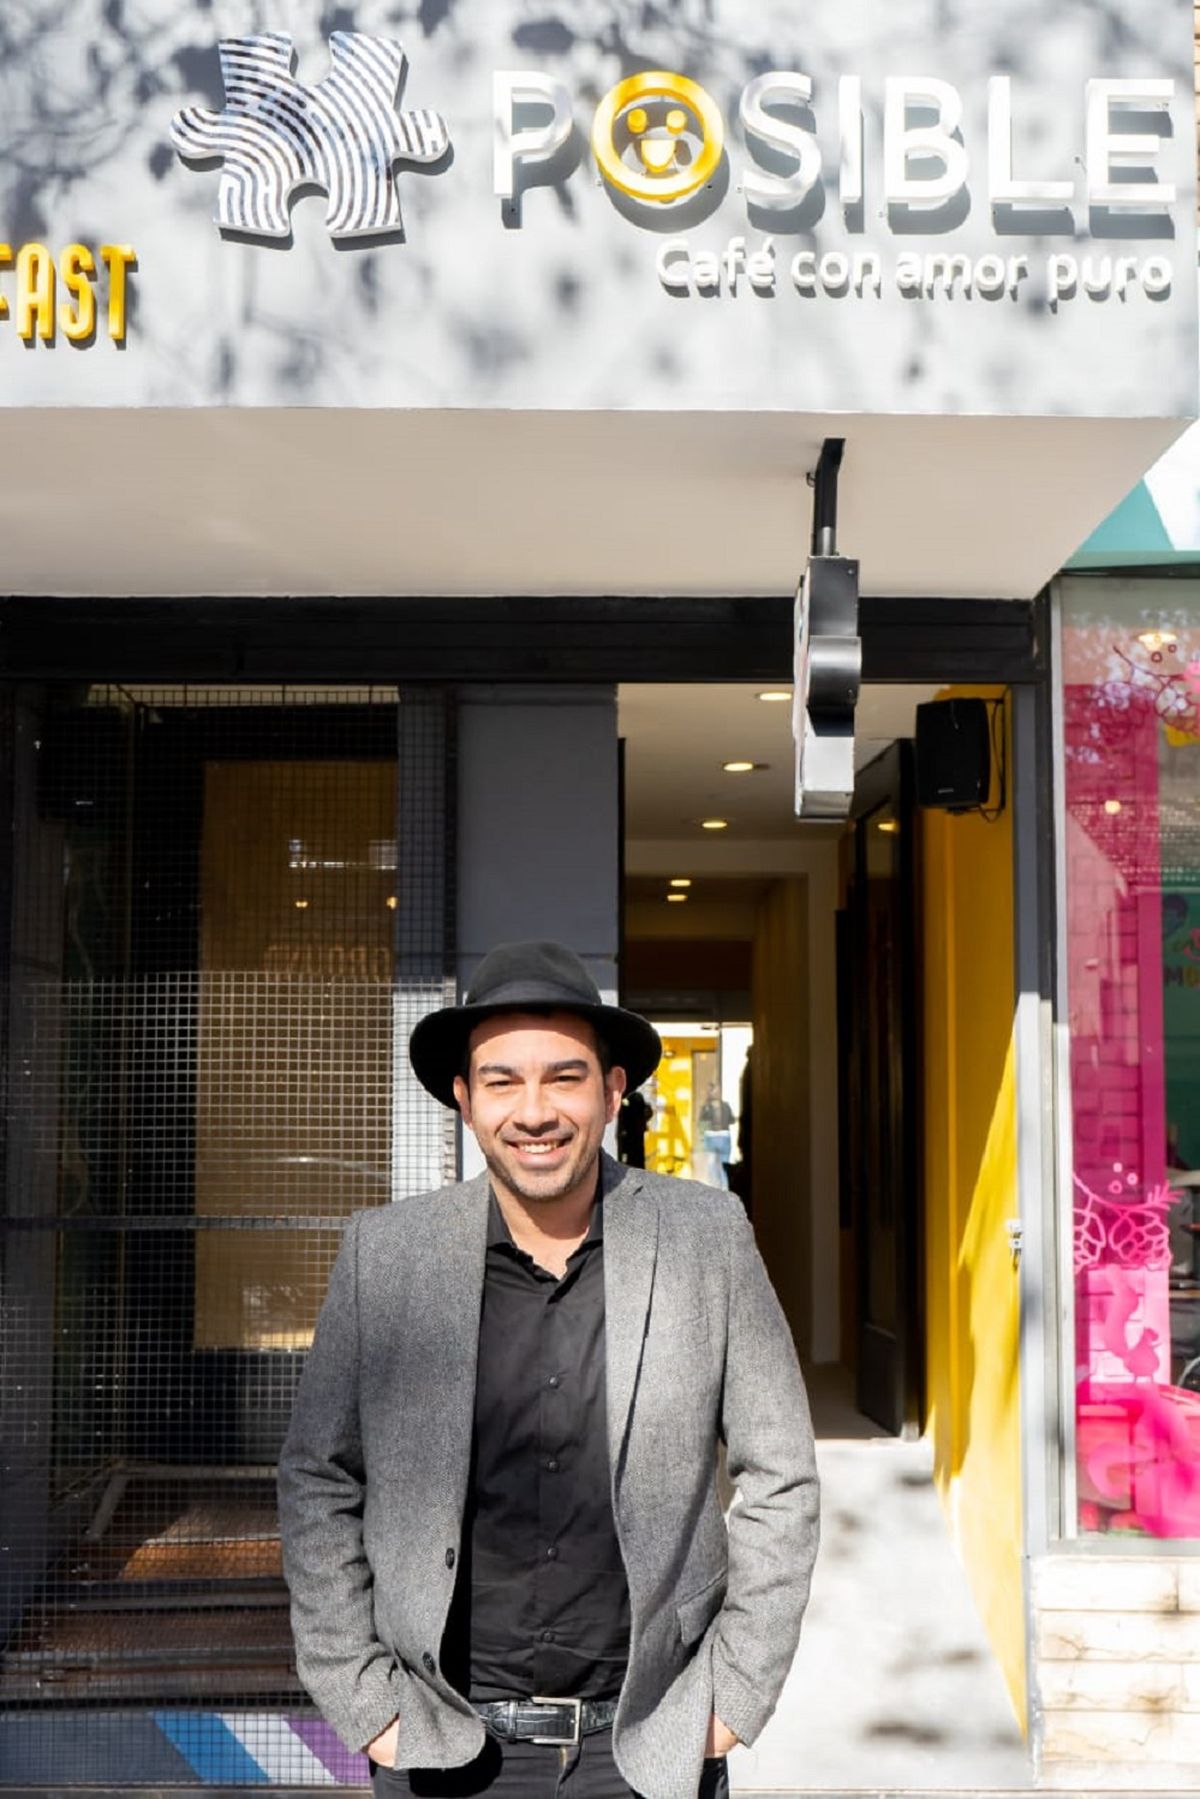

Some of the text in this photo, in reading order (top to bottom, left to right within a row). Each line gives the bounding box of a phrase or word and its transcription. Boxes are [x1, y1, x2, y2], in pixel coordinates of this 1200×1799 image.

[493, 70, 1177, 214] POSIBLE
[656, 236, 1173, 305] Café con amor puro
